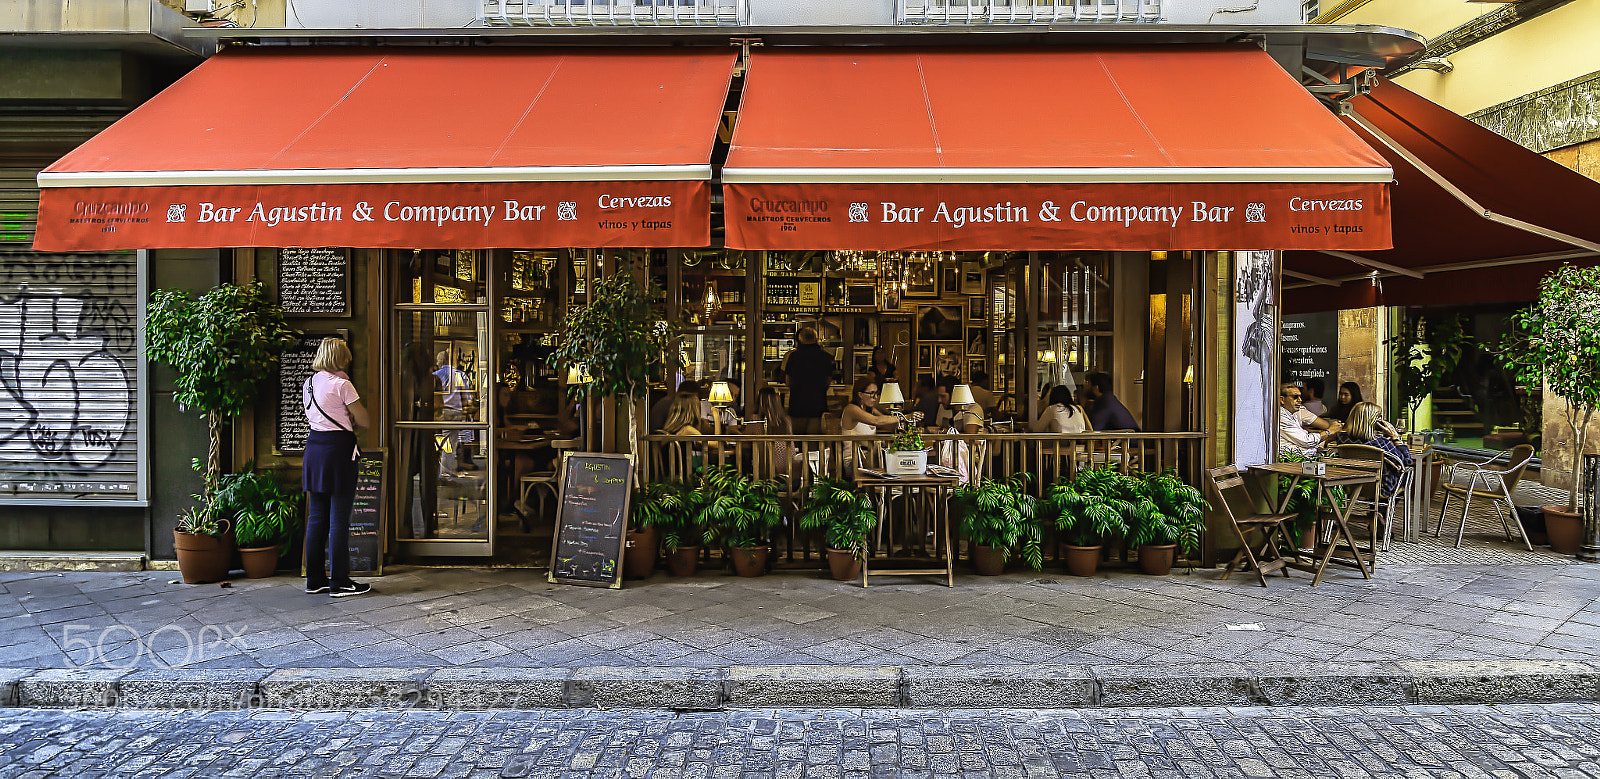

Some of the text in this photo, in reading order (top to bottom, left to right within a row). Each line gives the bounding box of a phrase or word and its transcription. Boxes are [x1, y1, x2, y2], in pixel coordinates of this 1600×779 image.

[74, 201, 149, 216] Cruzcampo
[599, 195, 672, 209] Cervezas
[749, 197, 829, 215] Cruzcampo
[1289, 196, 1363, 211] Cervezas
[197, 200, 546, 228] Bar Agustin & Company Bar
[880, 200, 1235, 229] Bar Agustin & Company Bar
[598, 219, 672, 231] vinos y tapas
[1290, 223, 1364, 236] vinos y tapas
